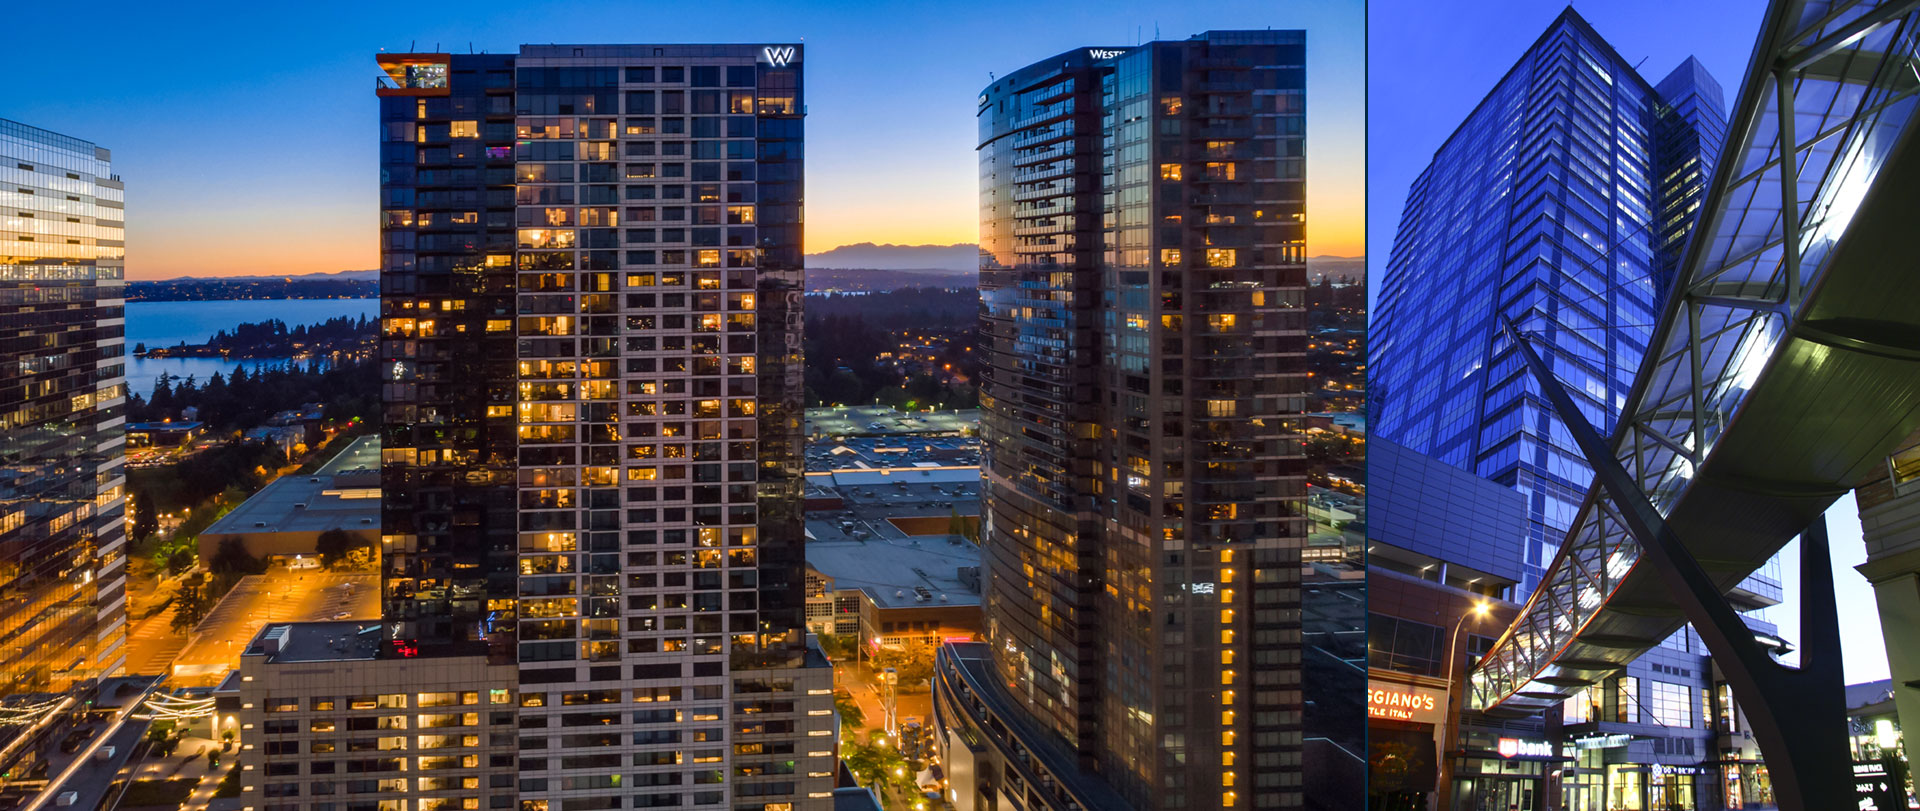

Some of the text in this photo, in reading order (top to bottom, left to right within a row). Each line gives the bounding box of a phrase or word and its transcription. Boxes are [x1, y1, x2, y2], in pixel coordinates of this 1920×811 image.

[765, 47, 794, 67] W
[1089, 49, 1126, 59] WEST
[1389, 708, 1413, 719] ITALY
